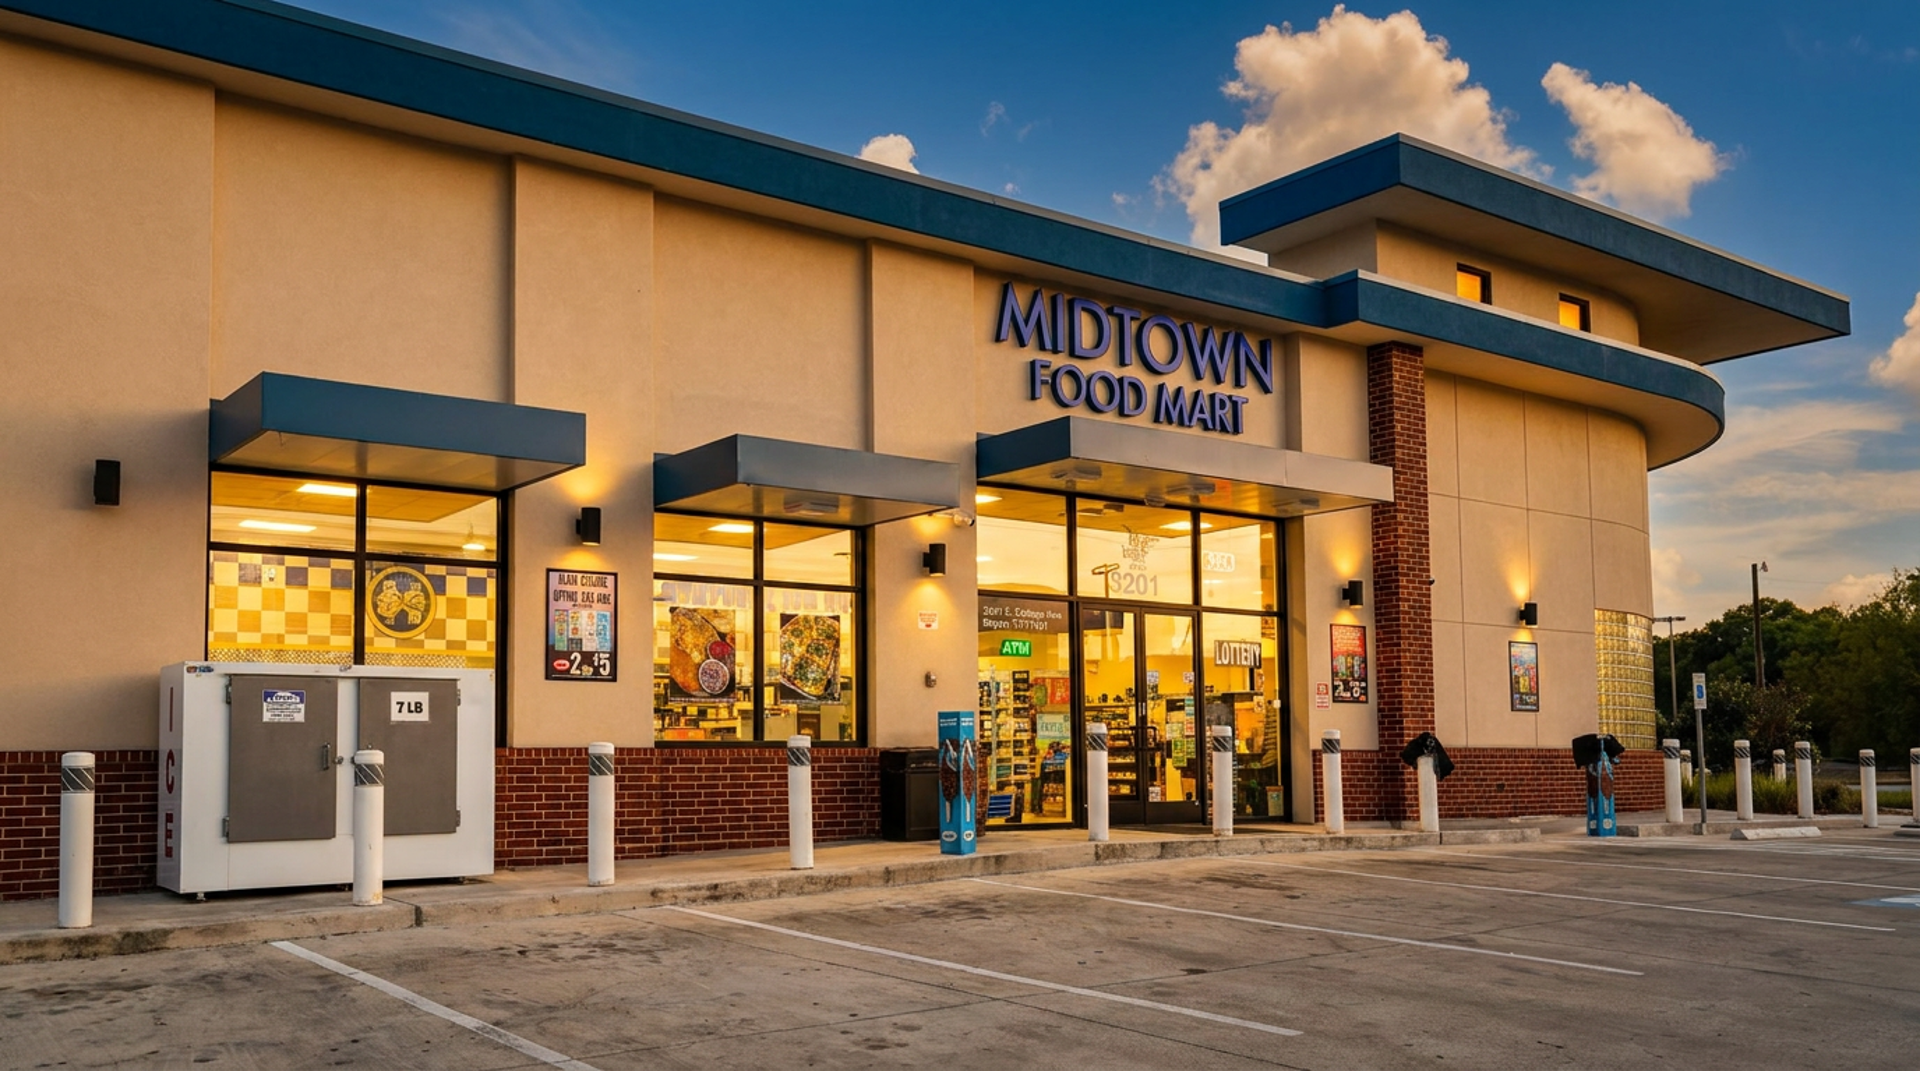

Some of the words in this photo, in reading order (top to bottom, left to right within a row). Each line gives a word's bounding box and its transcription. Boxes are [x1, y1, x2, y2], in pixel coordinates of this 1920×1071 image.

[995, 281, 1273, 394] MIDTOWN
[1030, 359, 1147, 417] FOOD
[1154, 382, 1249, 434] MART
[570, 652, 582, 675] 2
[1002, 641, 1031, 656] ATM
[396, 701, 405, 714] 7
[407, 701, 423, 714] LB
[164, 686, 175, 858] ICE
